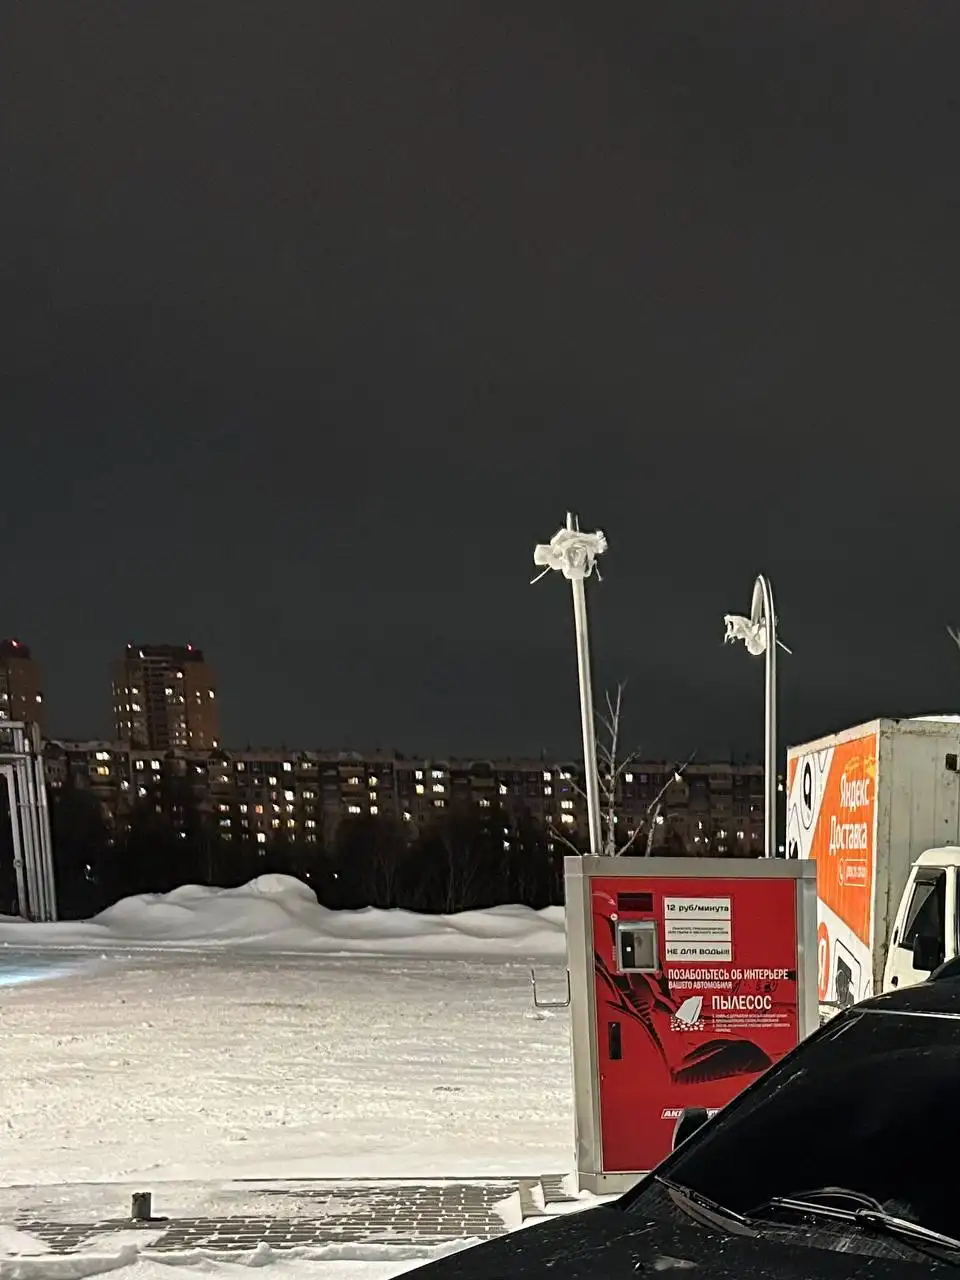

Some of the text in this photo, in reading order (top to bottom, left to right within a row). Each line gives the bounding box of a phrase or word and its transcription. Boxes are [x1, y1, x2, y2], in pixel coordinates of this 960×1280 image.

[840, 773, 870, 813] Яндекс
[828, 815, 868, 857] Доставка
[678, 904, 729, 913] руб/минута
[668, 969, 789, 980] ПОЗАБОТЬТЕСЬ ОБ ИНТЕРЬЕРЕ
[668, 981, 733, 989] ВАШЕГО АВТОМОБИЛЯ
[711, 995, 772, 1010] ПЫЛЕСОС
